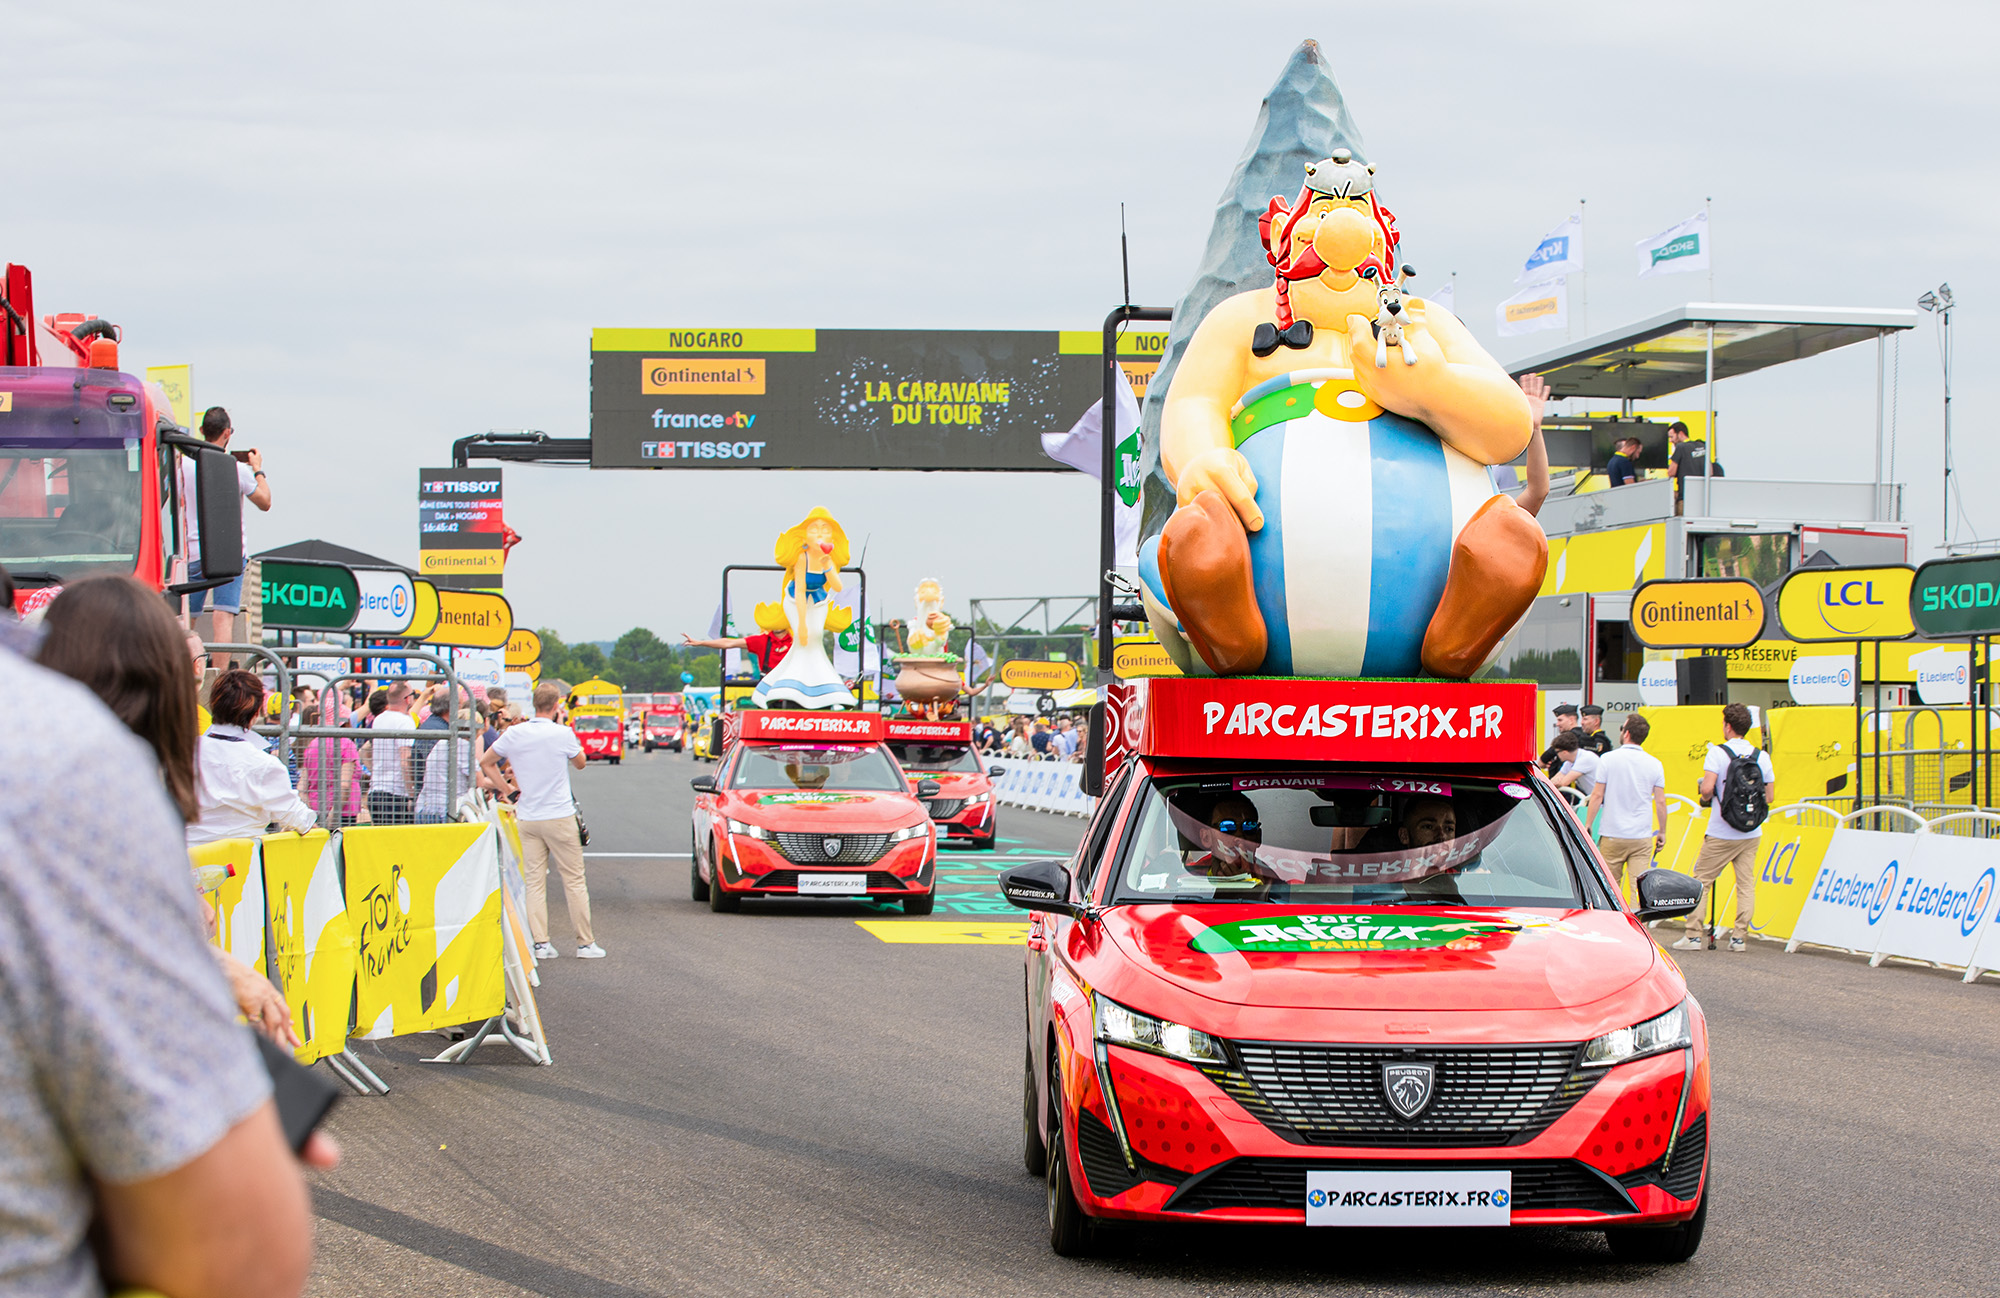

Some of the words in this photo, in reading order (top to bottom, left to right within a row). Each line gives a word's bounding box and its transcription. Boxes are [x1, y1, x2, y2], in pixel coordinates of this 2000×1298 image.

[669, 331, 743, 348] NOGARO
[651, 367, 741, 386] Continental
[865, 382, 892, 402] LA
[897, 382, 1010, 403] CARAVANE
[892, 403, 921, 424] DU
[927, 404, 982, 424] TOUR
[676, 441, 766, 459] TISSOT
[445, 481, 500, 493] TISSOT
[435, 512, 451, 520] DAX
[456, 512, 488, 520] NOGARO
[425, 555, 487, 569] Continental
[1824, 581, 1884, 606] LCL
[440, 607, 490, 627] inental
[1641, 600, 1738, 628] Continental
[1116, 653, 1173, 670] Continen
[1743, 646, 1797, 662] RÉSERVÉ
[1005, 667, 1062, 680] Continental
[1745, 664, 1772, 672] ACCESS
[1040, 699, 1054, 711] 50
[1238, 778, 1325, 787] CARAVANE
[1391, 780, 1442, 794] 9126
[1762, 841, 1801, 886] LCL
[1310, 940, 1385, 950] PARIS
